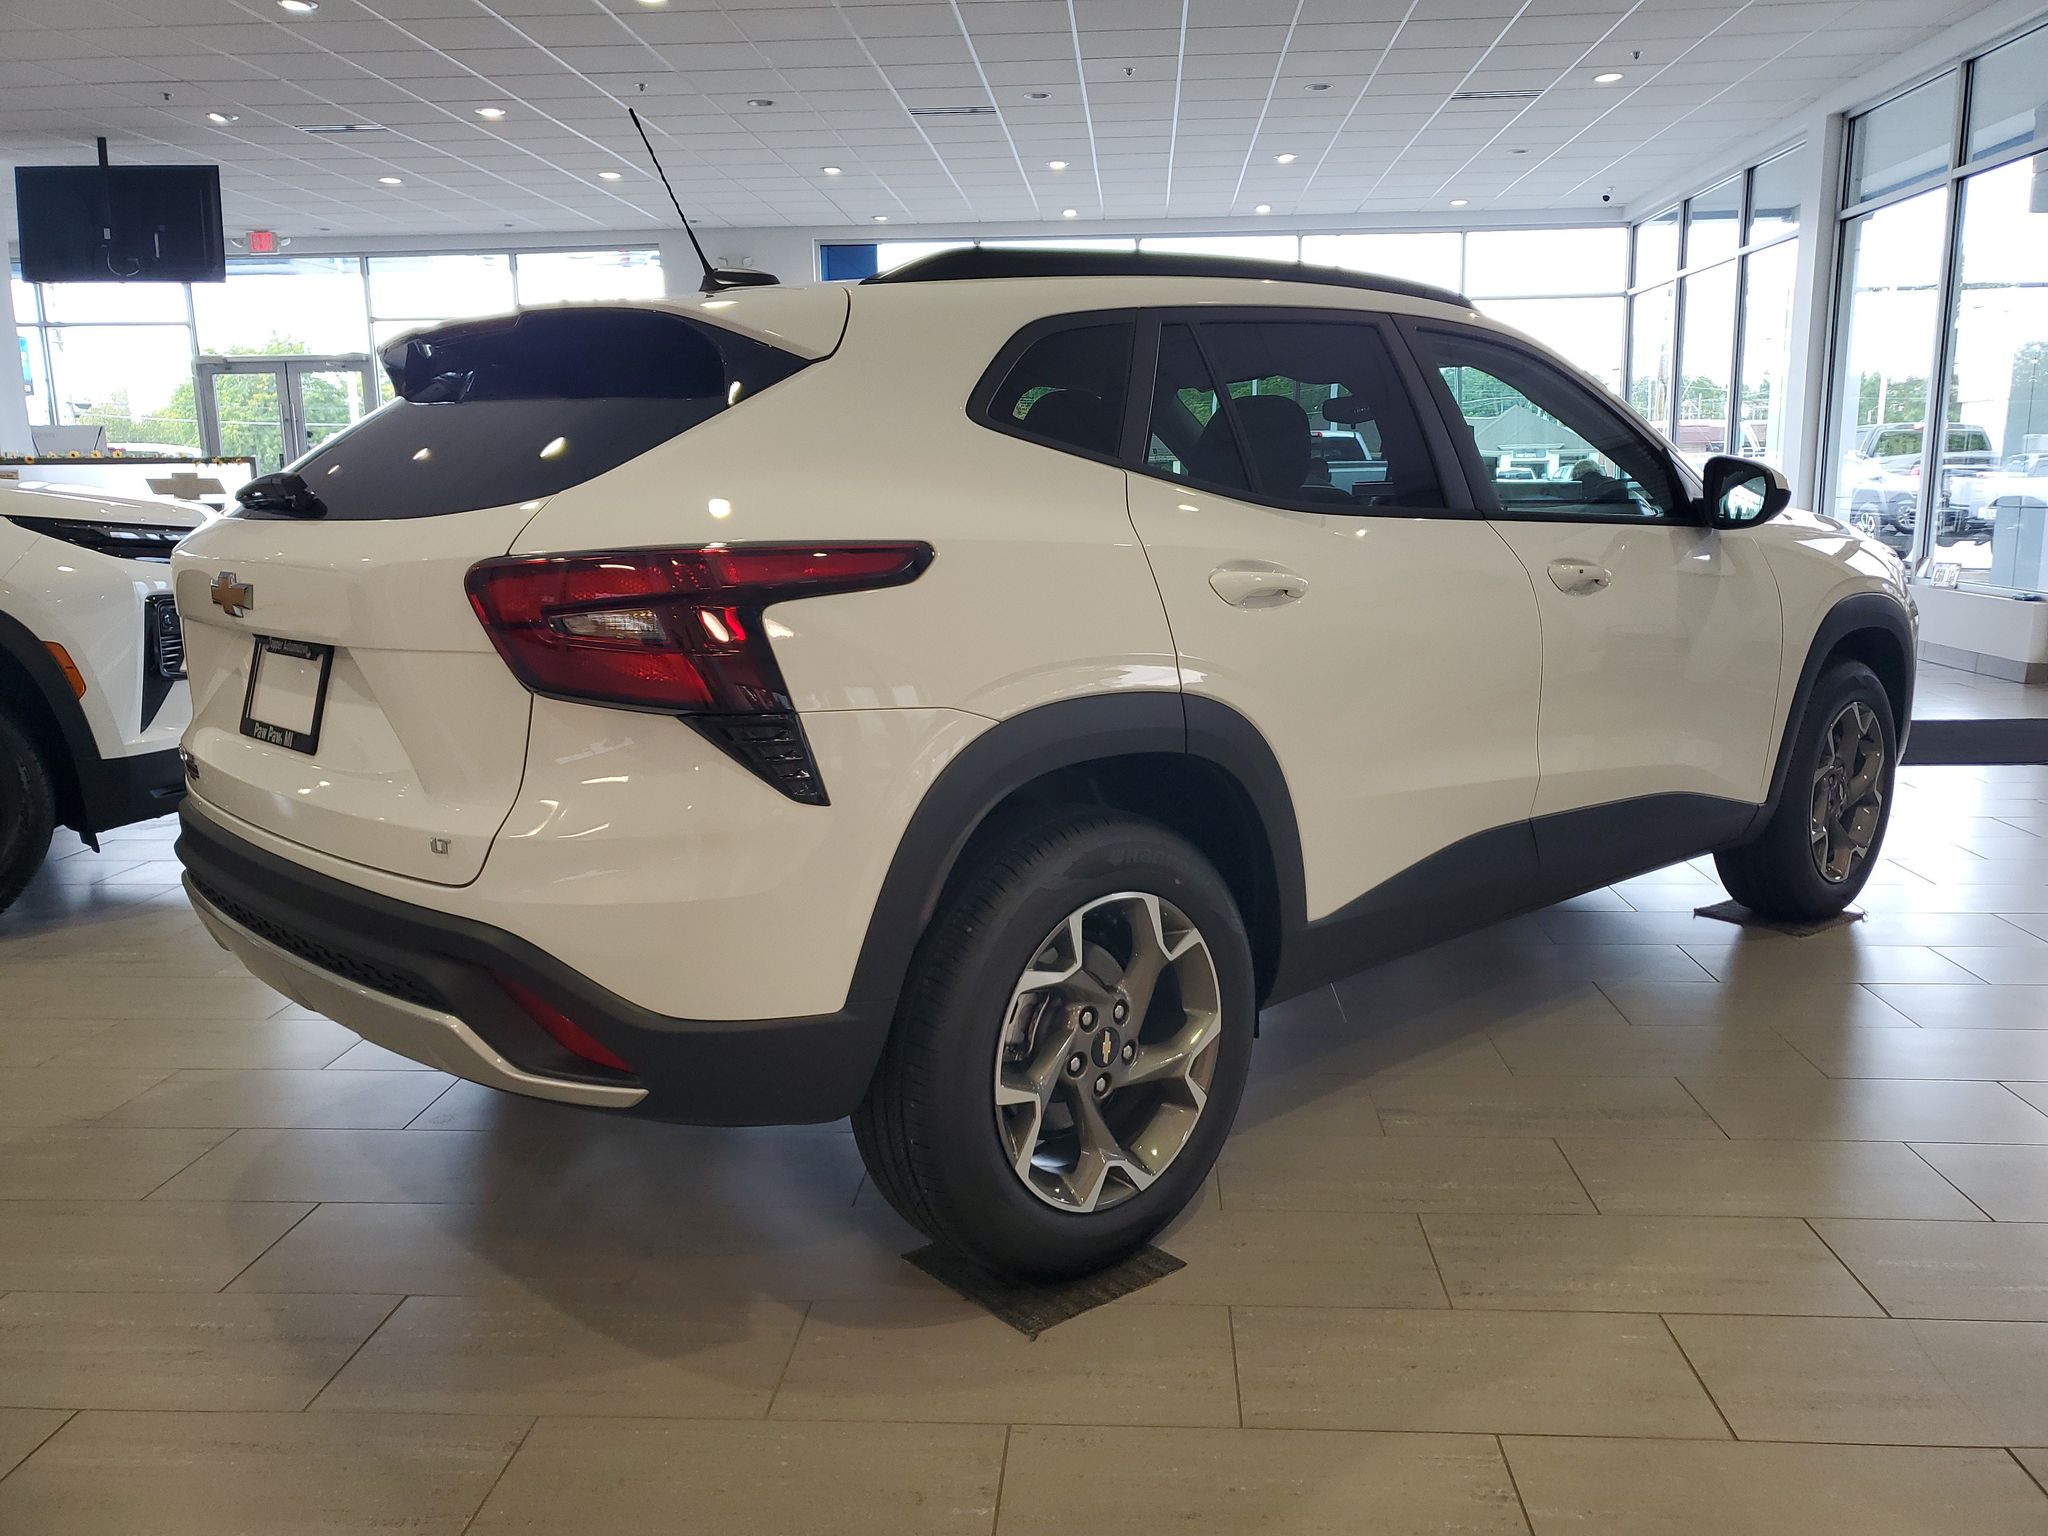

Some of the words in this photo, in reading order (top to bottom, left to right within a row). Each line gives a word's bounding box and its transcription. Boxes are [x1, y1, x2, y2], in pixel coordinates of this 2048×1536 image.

[253, 722, 268, 740] Paw
[283, 730, 294, 747] MI
[430, 837, 451, 855] LT
